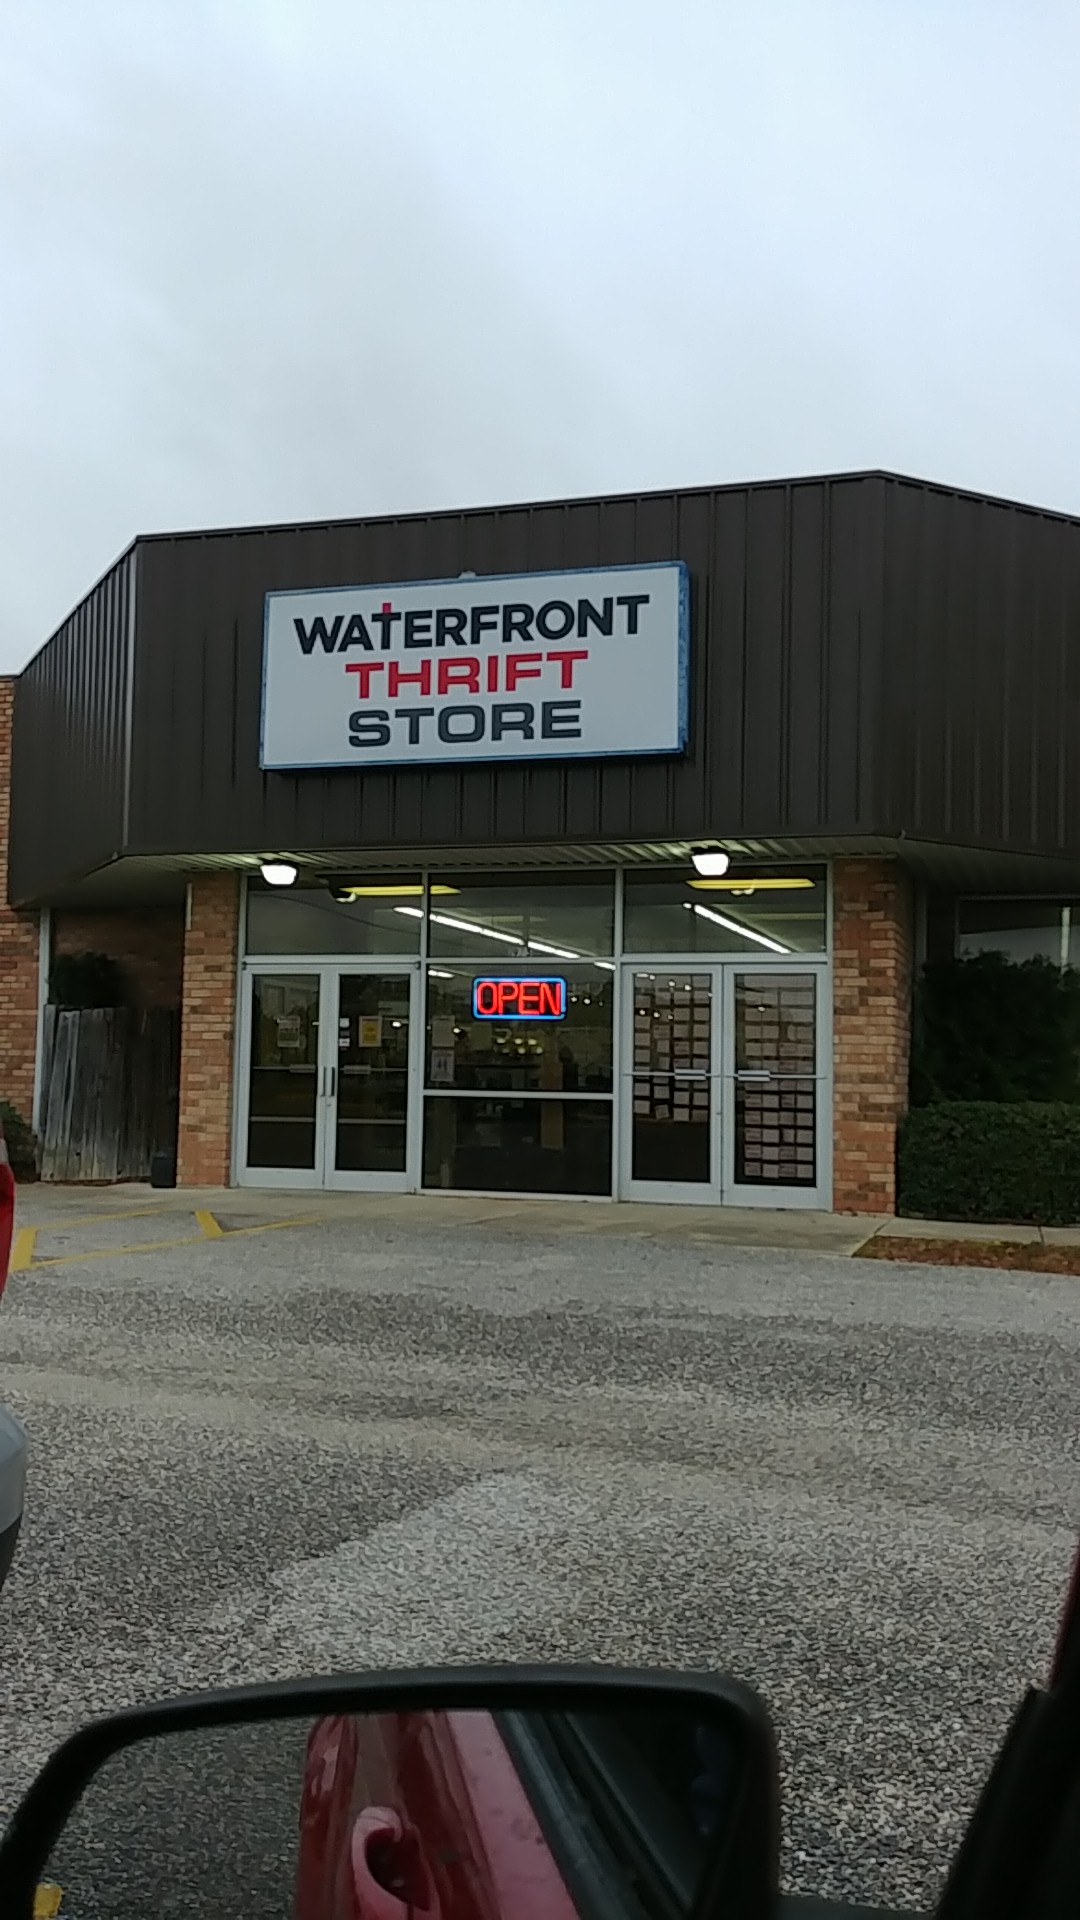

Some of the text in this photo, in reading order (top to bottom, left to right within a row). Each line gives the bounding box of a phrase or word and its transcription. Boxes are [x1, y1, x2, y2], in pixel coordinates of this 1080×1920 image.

[293, 595, 650, 654] WATERFRONT
[345, 650, 588, 698] THRIFT
[349, 701, 582, 747] STORE
[477, 981, 562, 1015] OPEN
